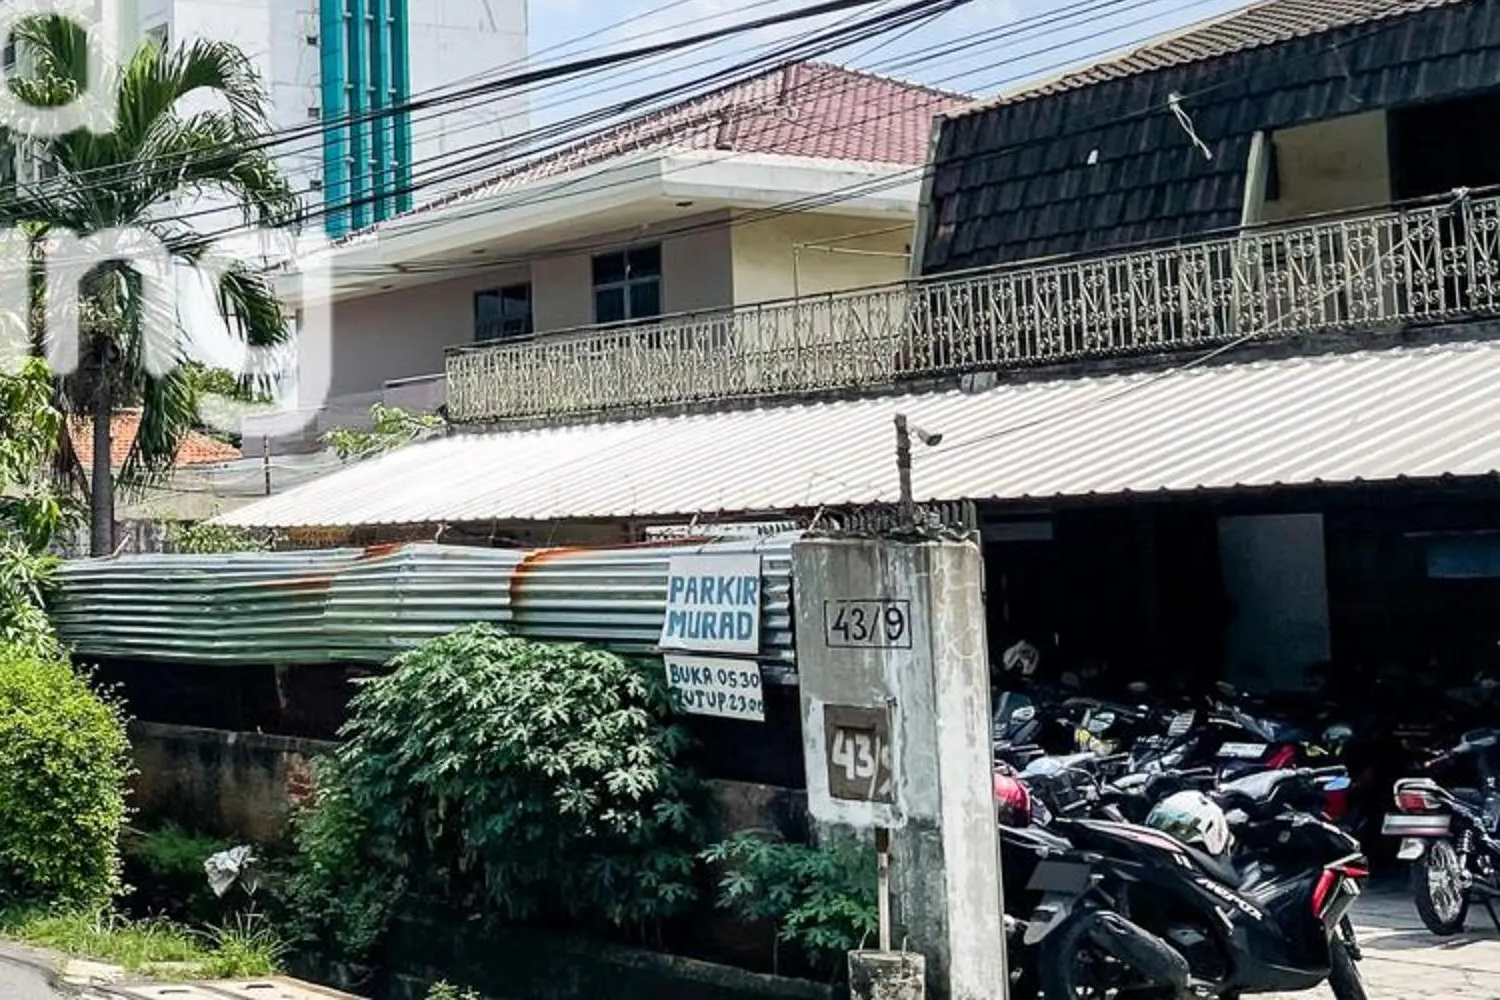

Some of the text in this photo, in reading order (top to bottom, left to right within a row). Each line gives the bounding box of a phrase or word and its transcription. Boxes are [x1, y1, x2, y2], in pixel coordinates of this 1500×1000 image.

[669, 575, 759, 606] PARKIR
[666, 610, 754, 641] MURAD
[831, 606, 904, 642] 43/9
[669, 663, 714, 685] BUKA
